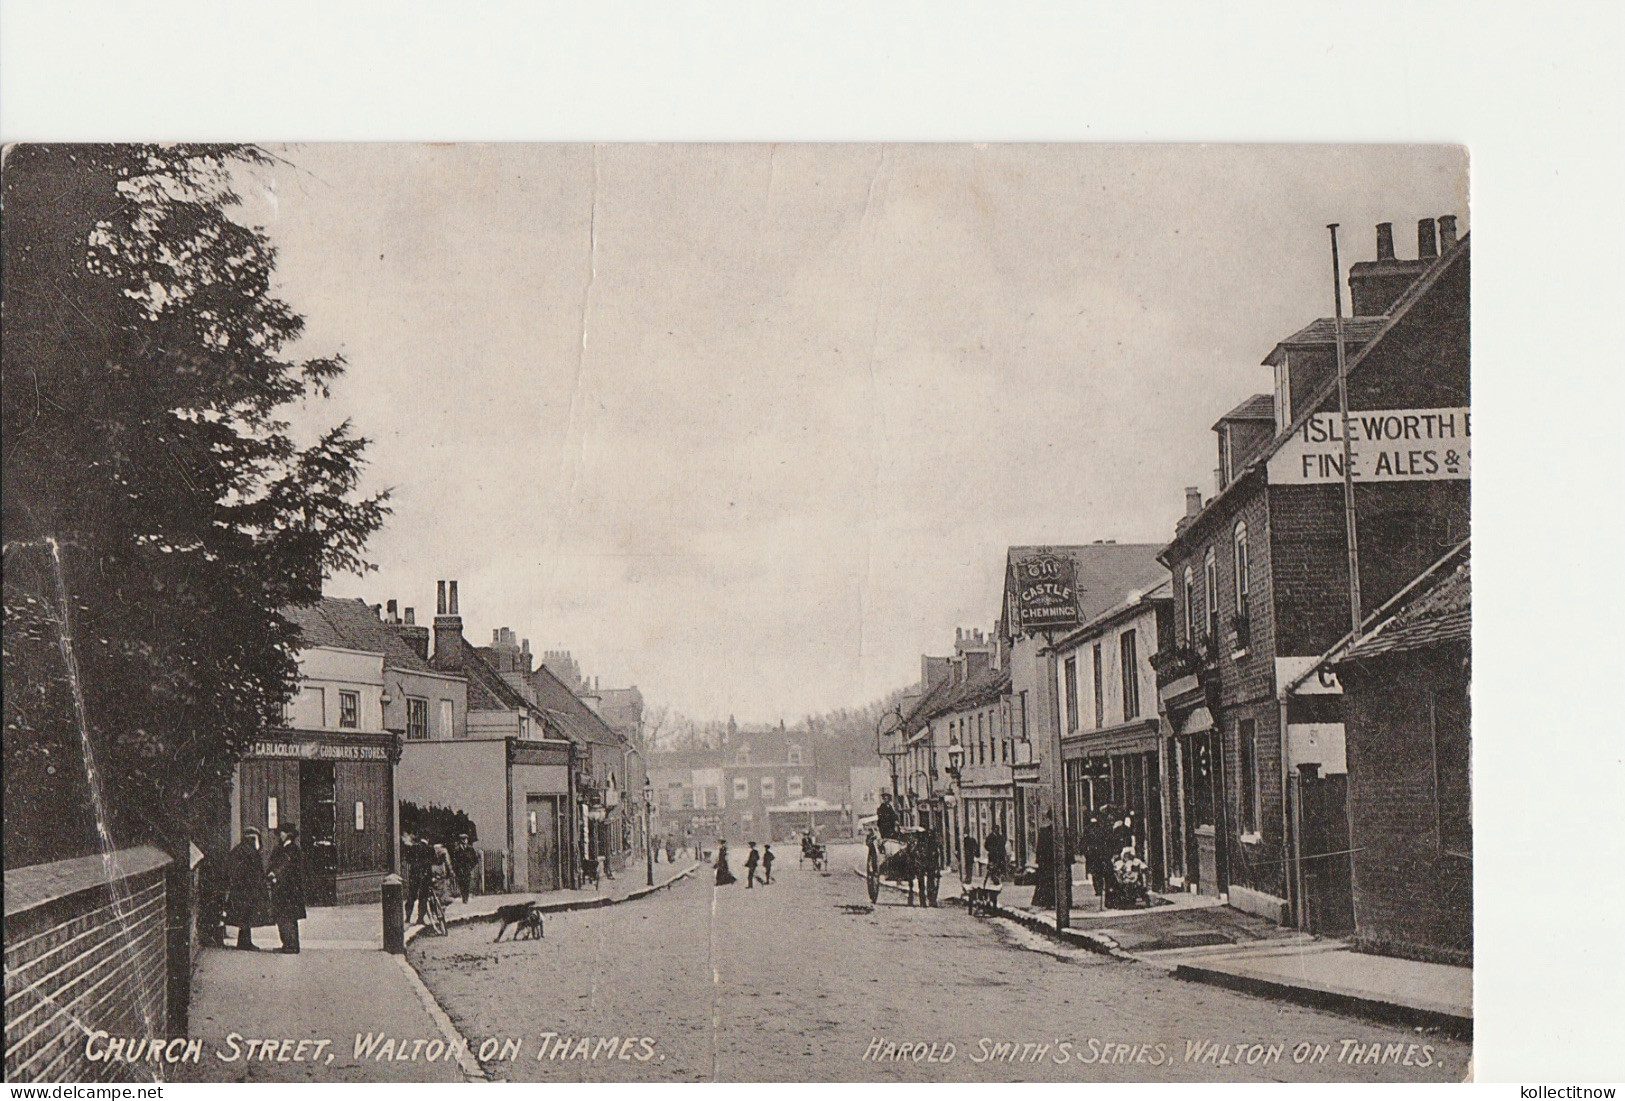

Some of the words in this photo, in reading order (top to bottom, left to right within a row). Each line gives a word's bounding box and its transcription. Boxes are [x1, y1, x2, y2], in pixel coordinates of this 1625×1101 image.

[1303, 413, 1455, 443] ISLEWORTH
[1302, 453, 1361, 478] FINE
[1375, 450, 1439, 476] ALES
[1444, 449, 1460, 473] &
[1022, 584, 1072, 601] CASTLE
